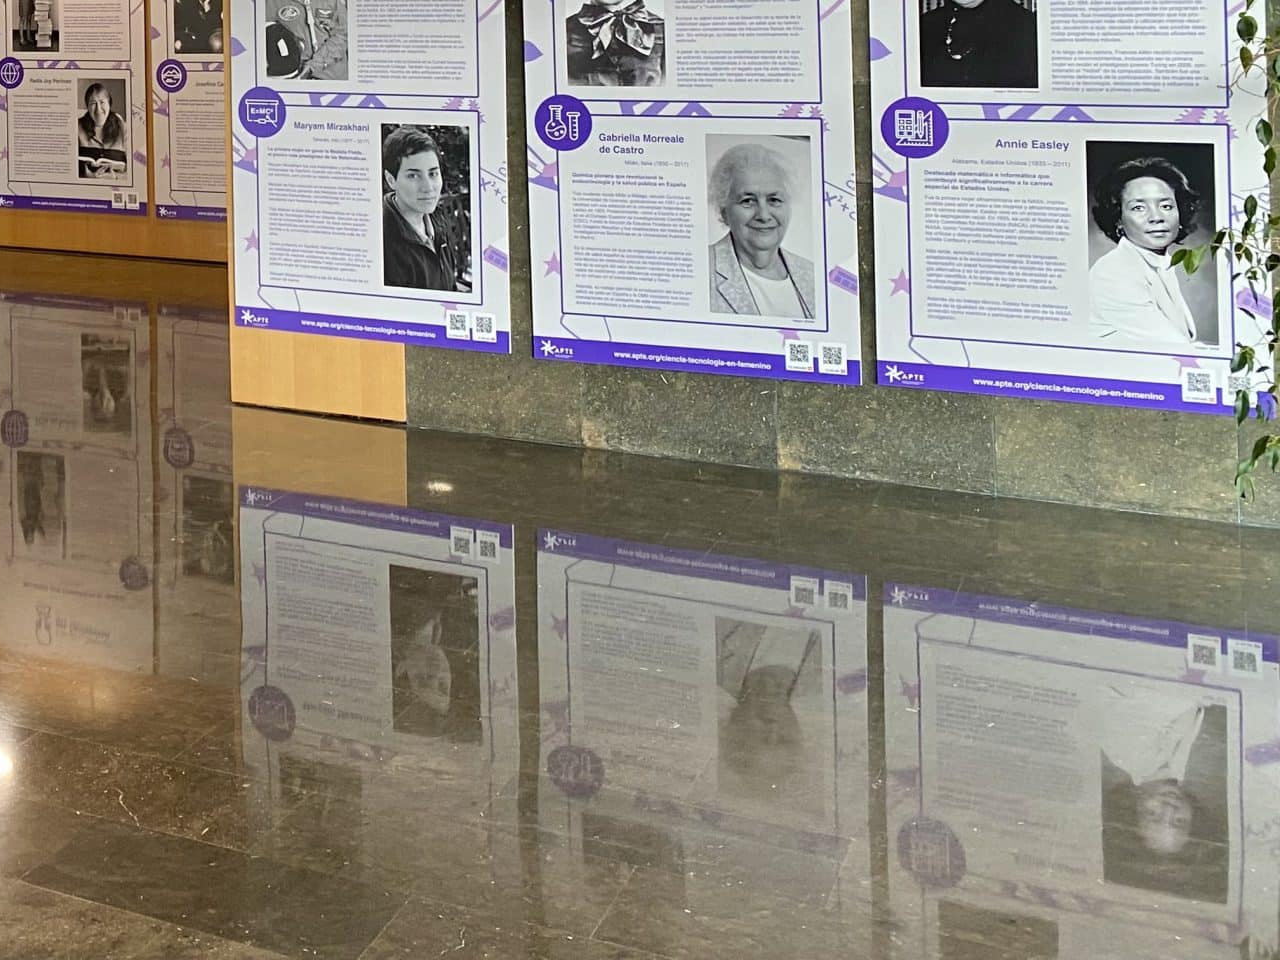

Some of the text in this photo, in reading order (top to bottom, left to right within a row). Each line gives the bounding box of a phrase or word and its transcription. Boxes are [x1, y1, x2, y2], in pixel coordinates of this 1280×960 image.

[293, 121, 370, 132] Maryam Mirzakhani
[598, 133, 685, 143] Gabriella Morreale
[599, 145, 644, 154] de Castro
[995, 139, 1070, 152] Annie Easley
[902, 373, 925, 382] APTE
